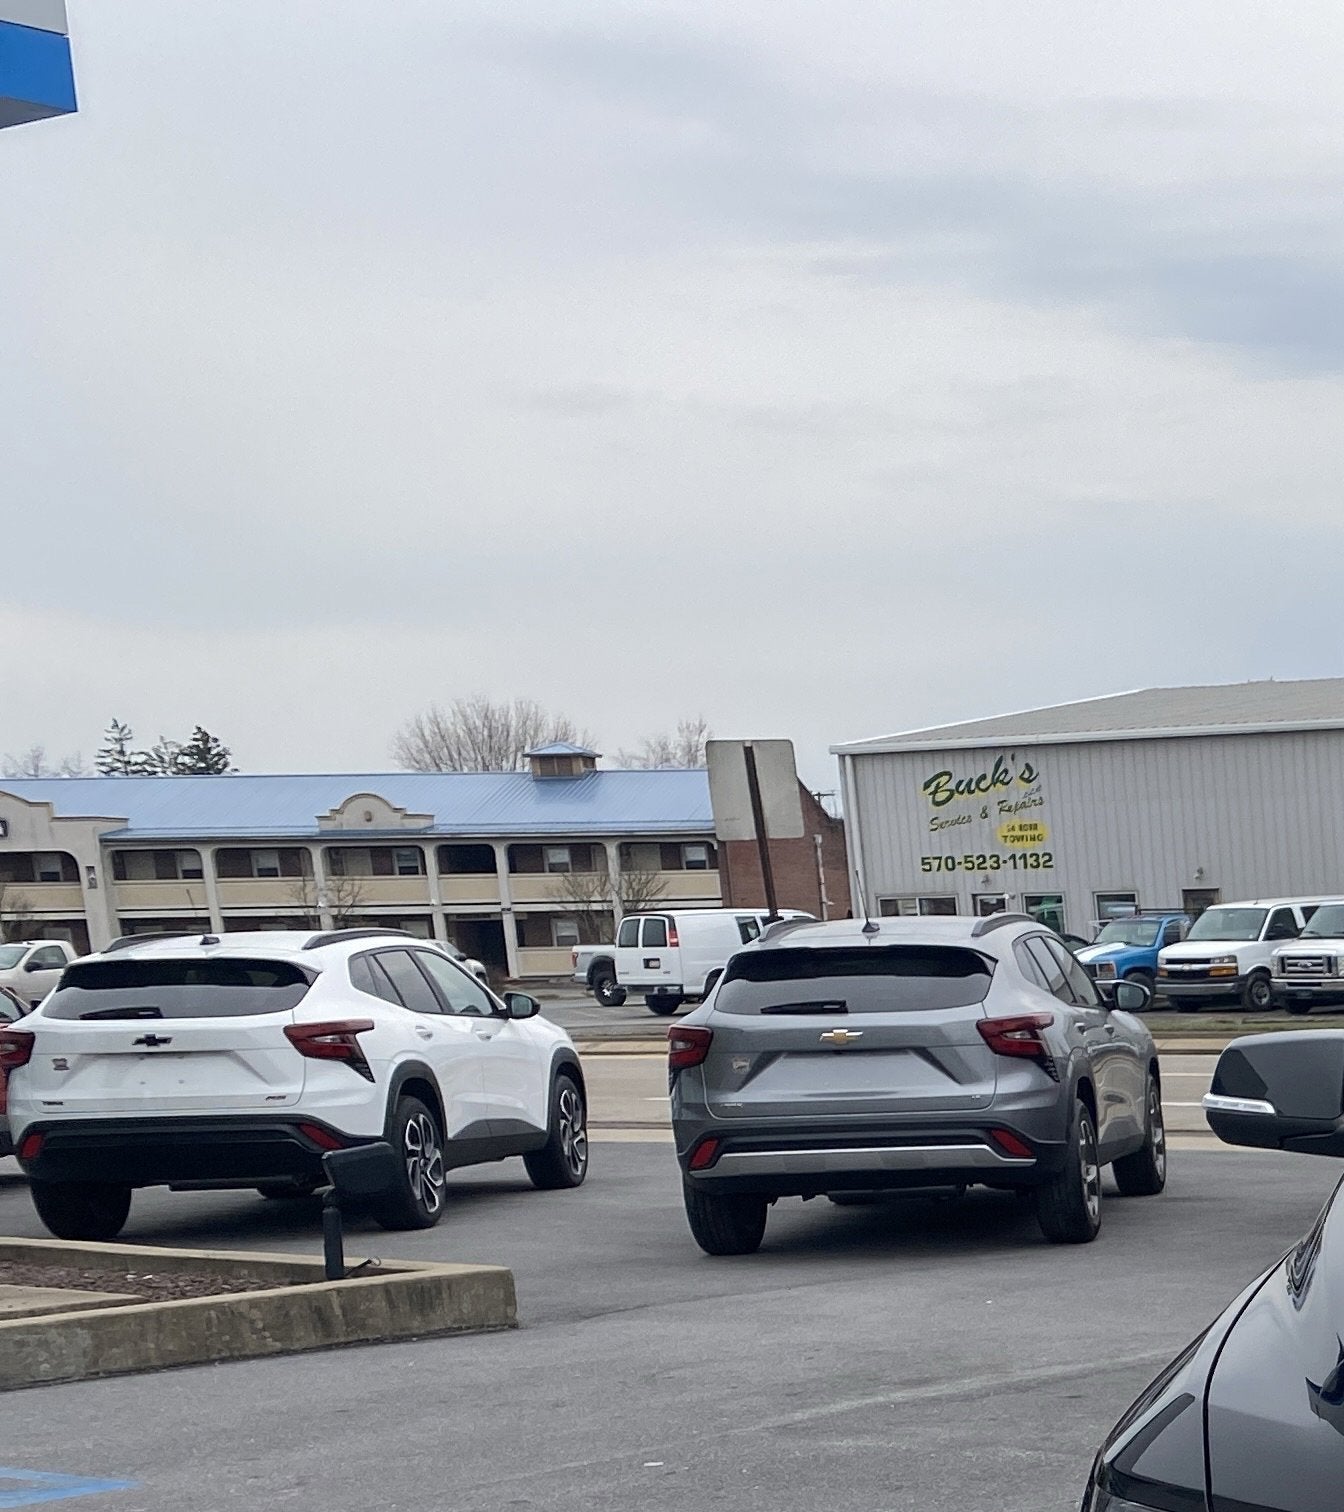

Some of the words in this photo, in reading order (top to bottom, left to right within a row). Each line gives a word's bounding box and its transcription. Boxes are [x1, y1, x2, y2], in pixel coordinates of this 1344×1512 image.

[922, 753, 1040, 807] Buck's
[979, 805, 988, 819] &
[997, 796, 1044, 815] Repairs
[1001, 833, 1044, 843] TOWING
[920, 852, 1054, 872] 570-523-1132
